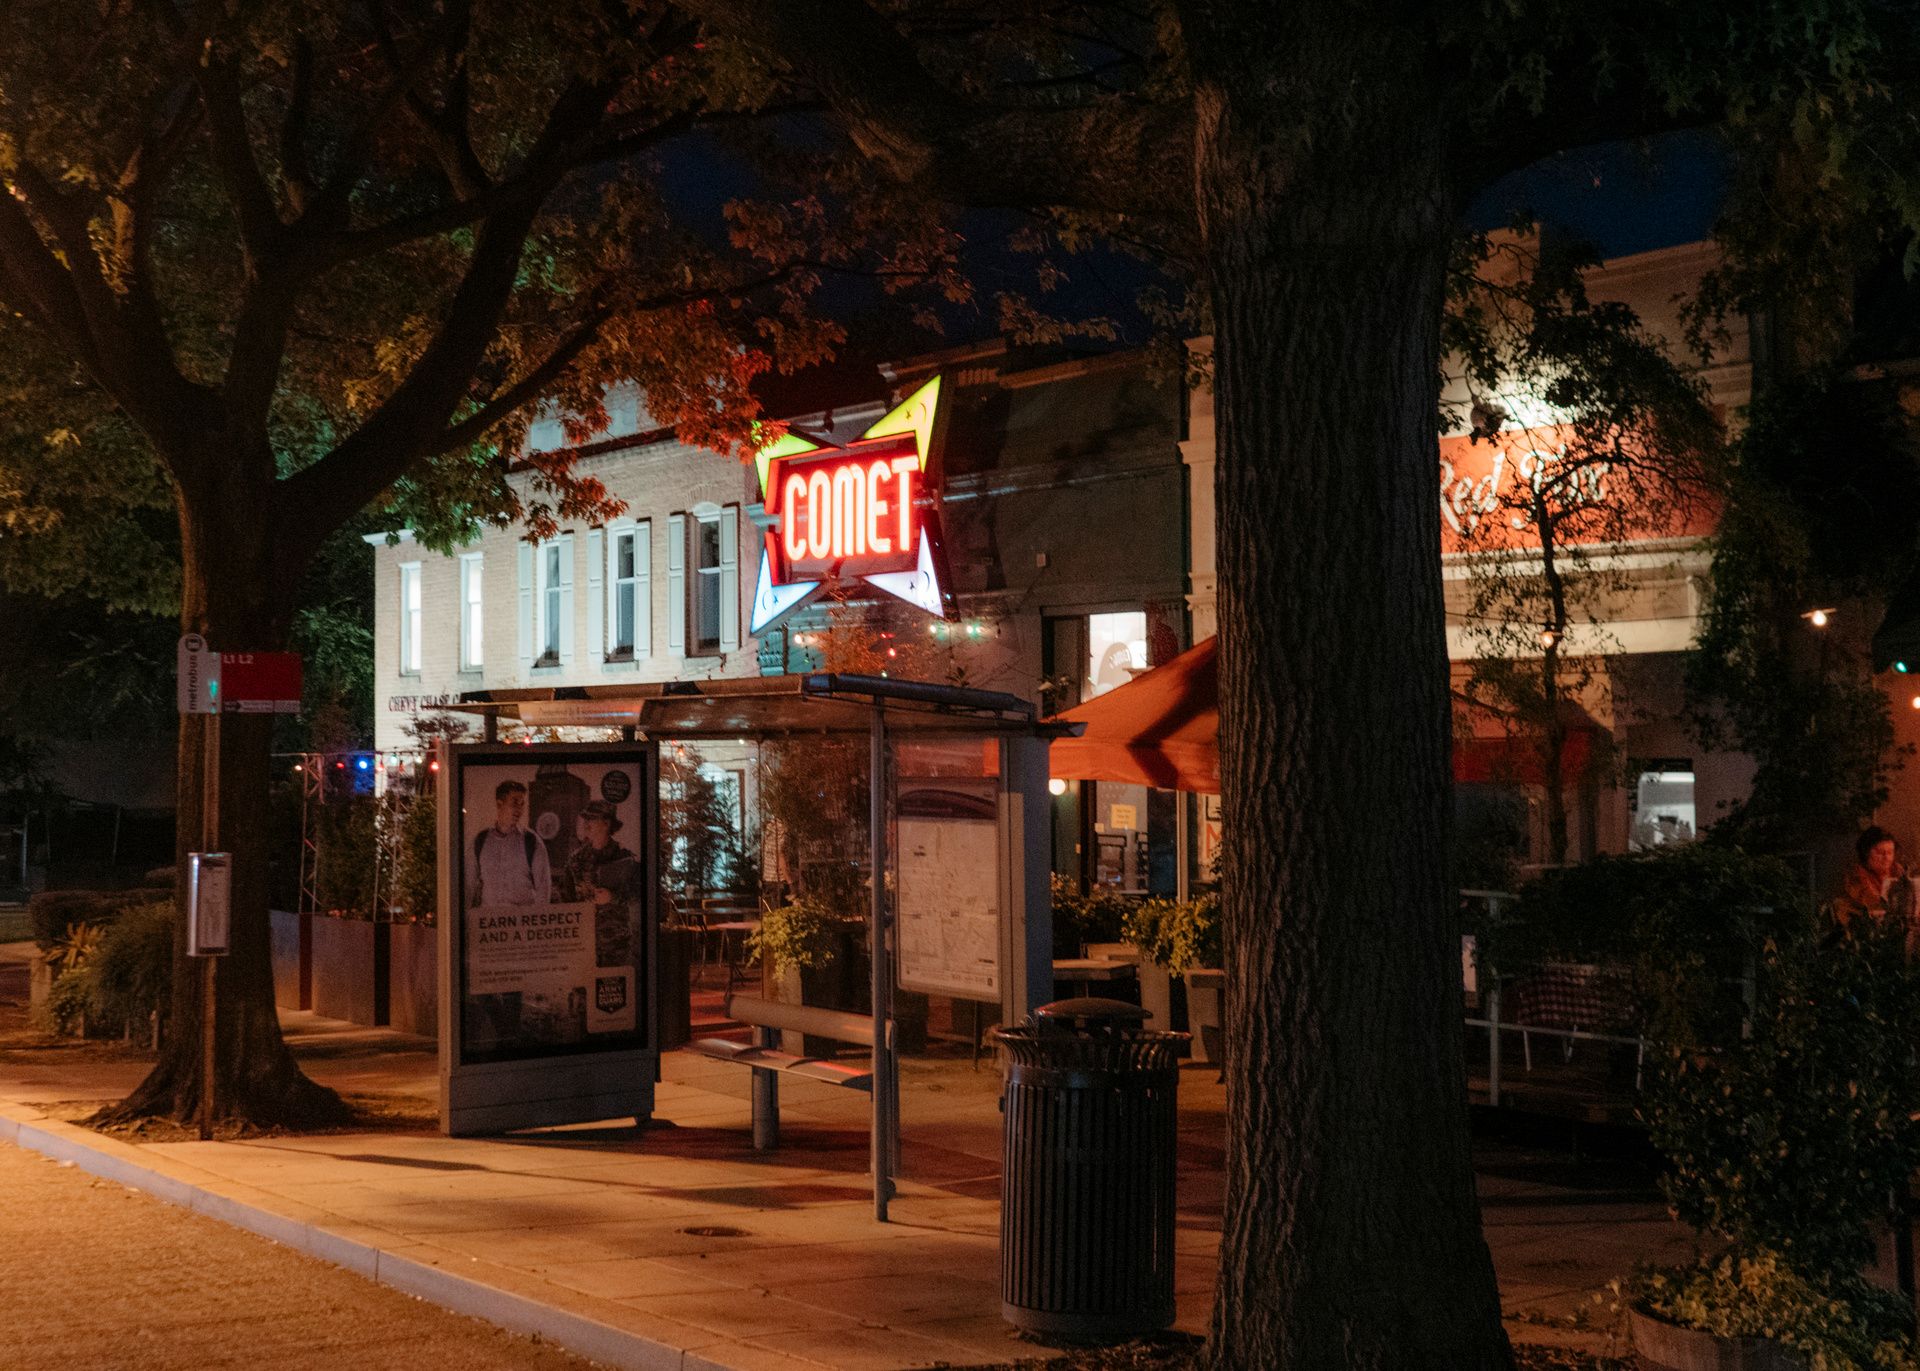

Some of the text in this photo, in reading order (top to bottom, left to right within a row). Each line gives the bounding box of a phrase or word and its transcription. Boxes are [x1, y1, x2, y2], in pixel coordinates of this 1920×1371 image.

[784, 455, 919, 561] COMET
[1440, 452, 1505, 534] Red
[223, 654, 254, 664] L1 L2
[188, 655, 198, 710] metrobus
[479, 912, 582, 929] EARN RESPECT
[479, 927, 579, 944] AND A DEGREE
